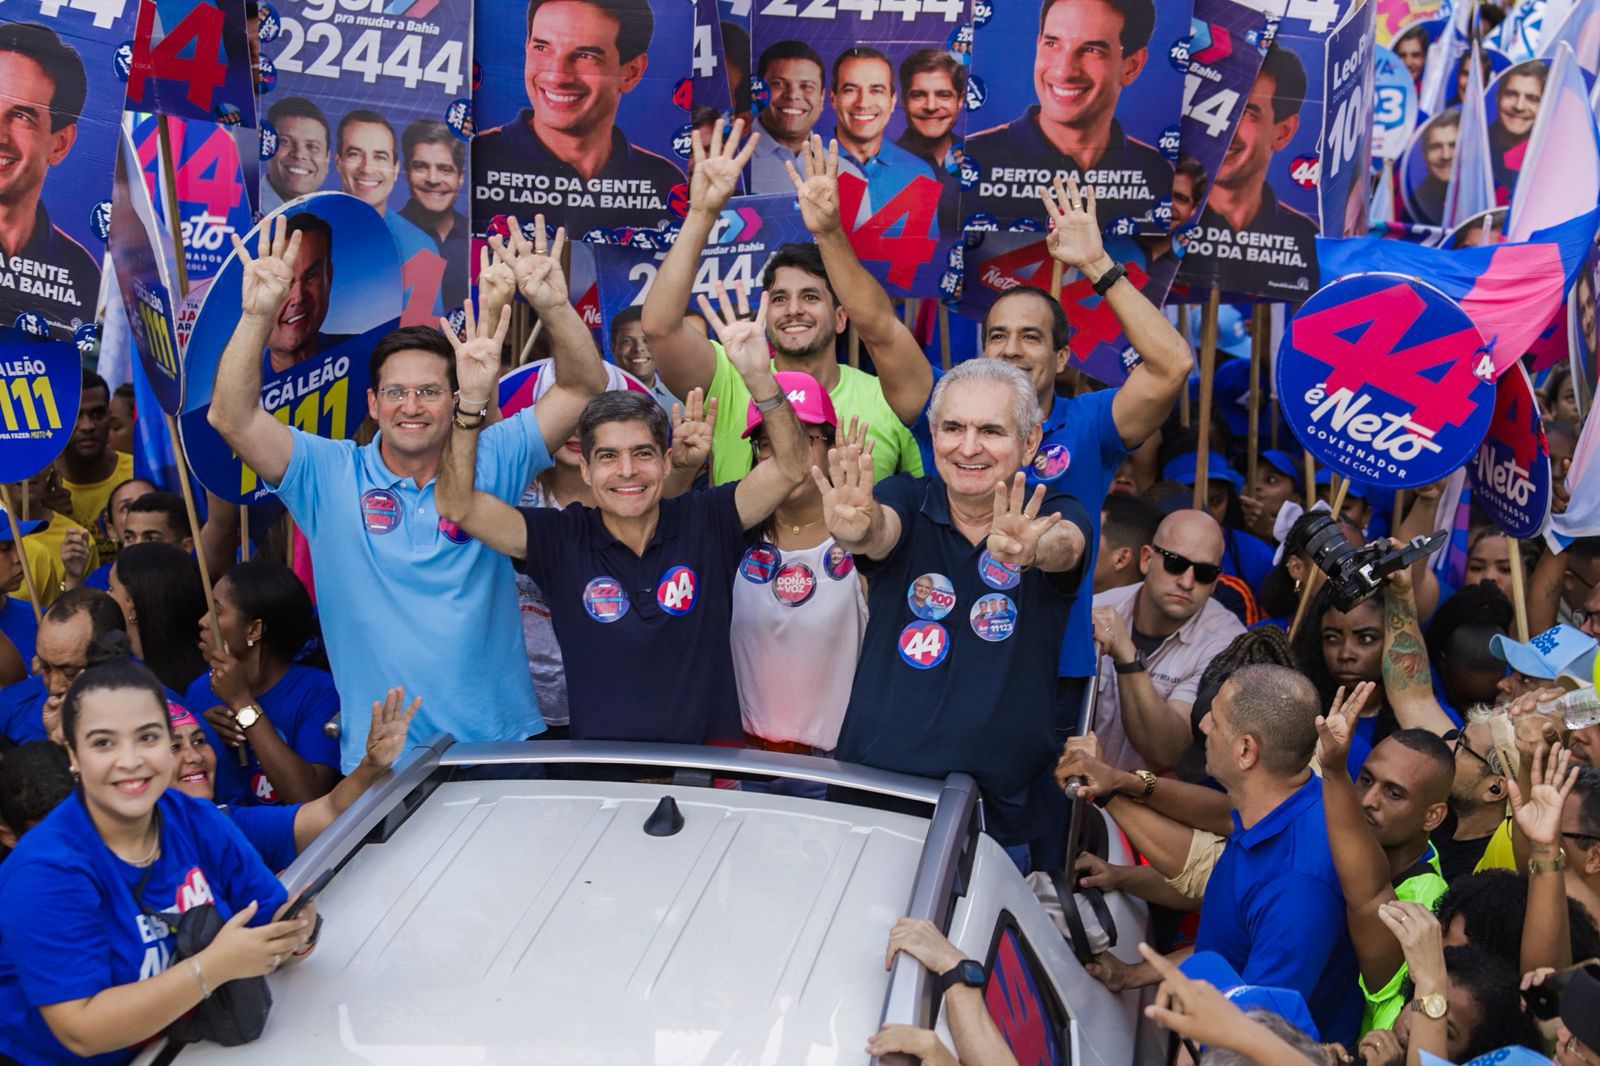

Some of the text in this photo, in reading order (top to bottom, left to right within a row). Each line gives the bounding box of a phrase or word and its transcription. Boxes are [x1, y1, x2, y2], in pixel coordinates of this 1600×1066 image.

[334, 13, 440, 35] pra mudar a Bahia
[273, 16, 464, 95] 22444
[1189, 62, 1222, 82] Bahia
[487, 171, 656, 194] PERTO DA GENTE.
[991, 167, 1147, 185] PERTO DA GENTE.
[1291, 161, 1319, 186] 44
[476, 186, 668, 211] DO LADO DA BAHIA.
[979, 182, 1007, 197] DO
[1095, 184, 1155, 200] BAHIA.
[183, 211, 235, 250] eto
[1207, 227, 1233, 244] DA
[1236, 230, 1299, 251] GENTE.
[738, 242, 765, 253] Bahia
[1187, 240, 1308, 268] DO DA BAHIA.
[9, 257, 73, 285] GENTE.
[19, 277, 82, 307] BAHIA.
[583, 309, 602, 325] Ne
[7, 356, 46, 376] LEÃO
[1292, 283, 1487, 441] 44
[259, 355, 350, 411] CÁ LEÃO
[787, 389, 806, 403] 44
[1309, 386, 1443, 462] Neto
[1307, 425, 1407, 479] GOVERNADOR
[1478, 444, 1537, 507] Neto
[664, 572, 693, 608] 44
[776, 577, 813, 586] DONAS
[785, 585, 805, 593] VOZ
[904, 628, 941, 661] 44
